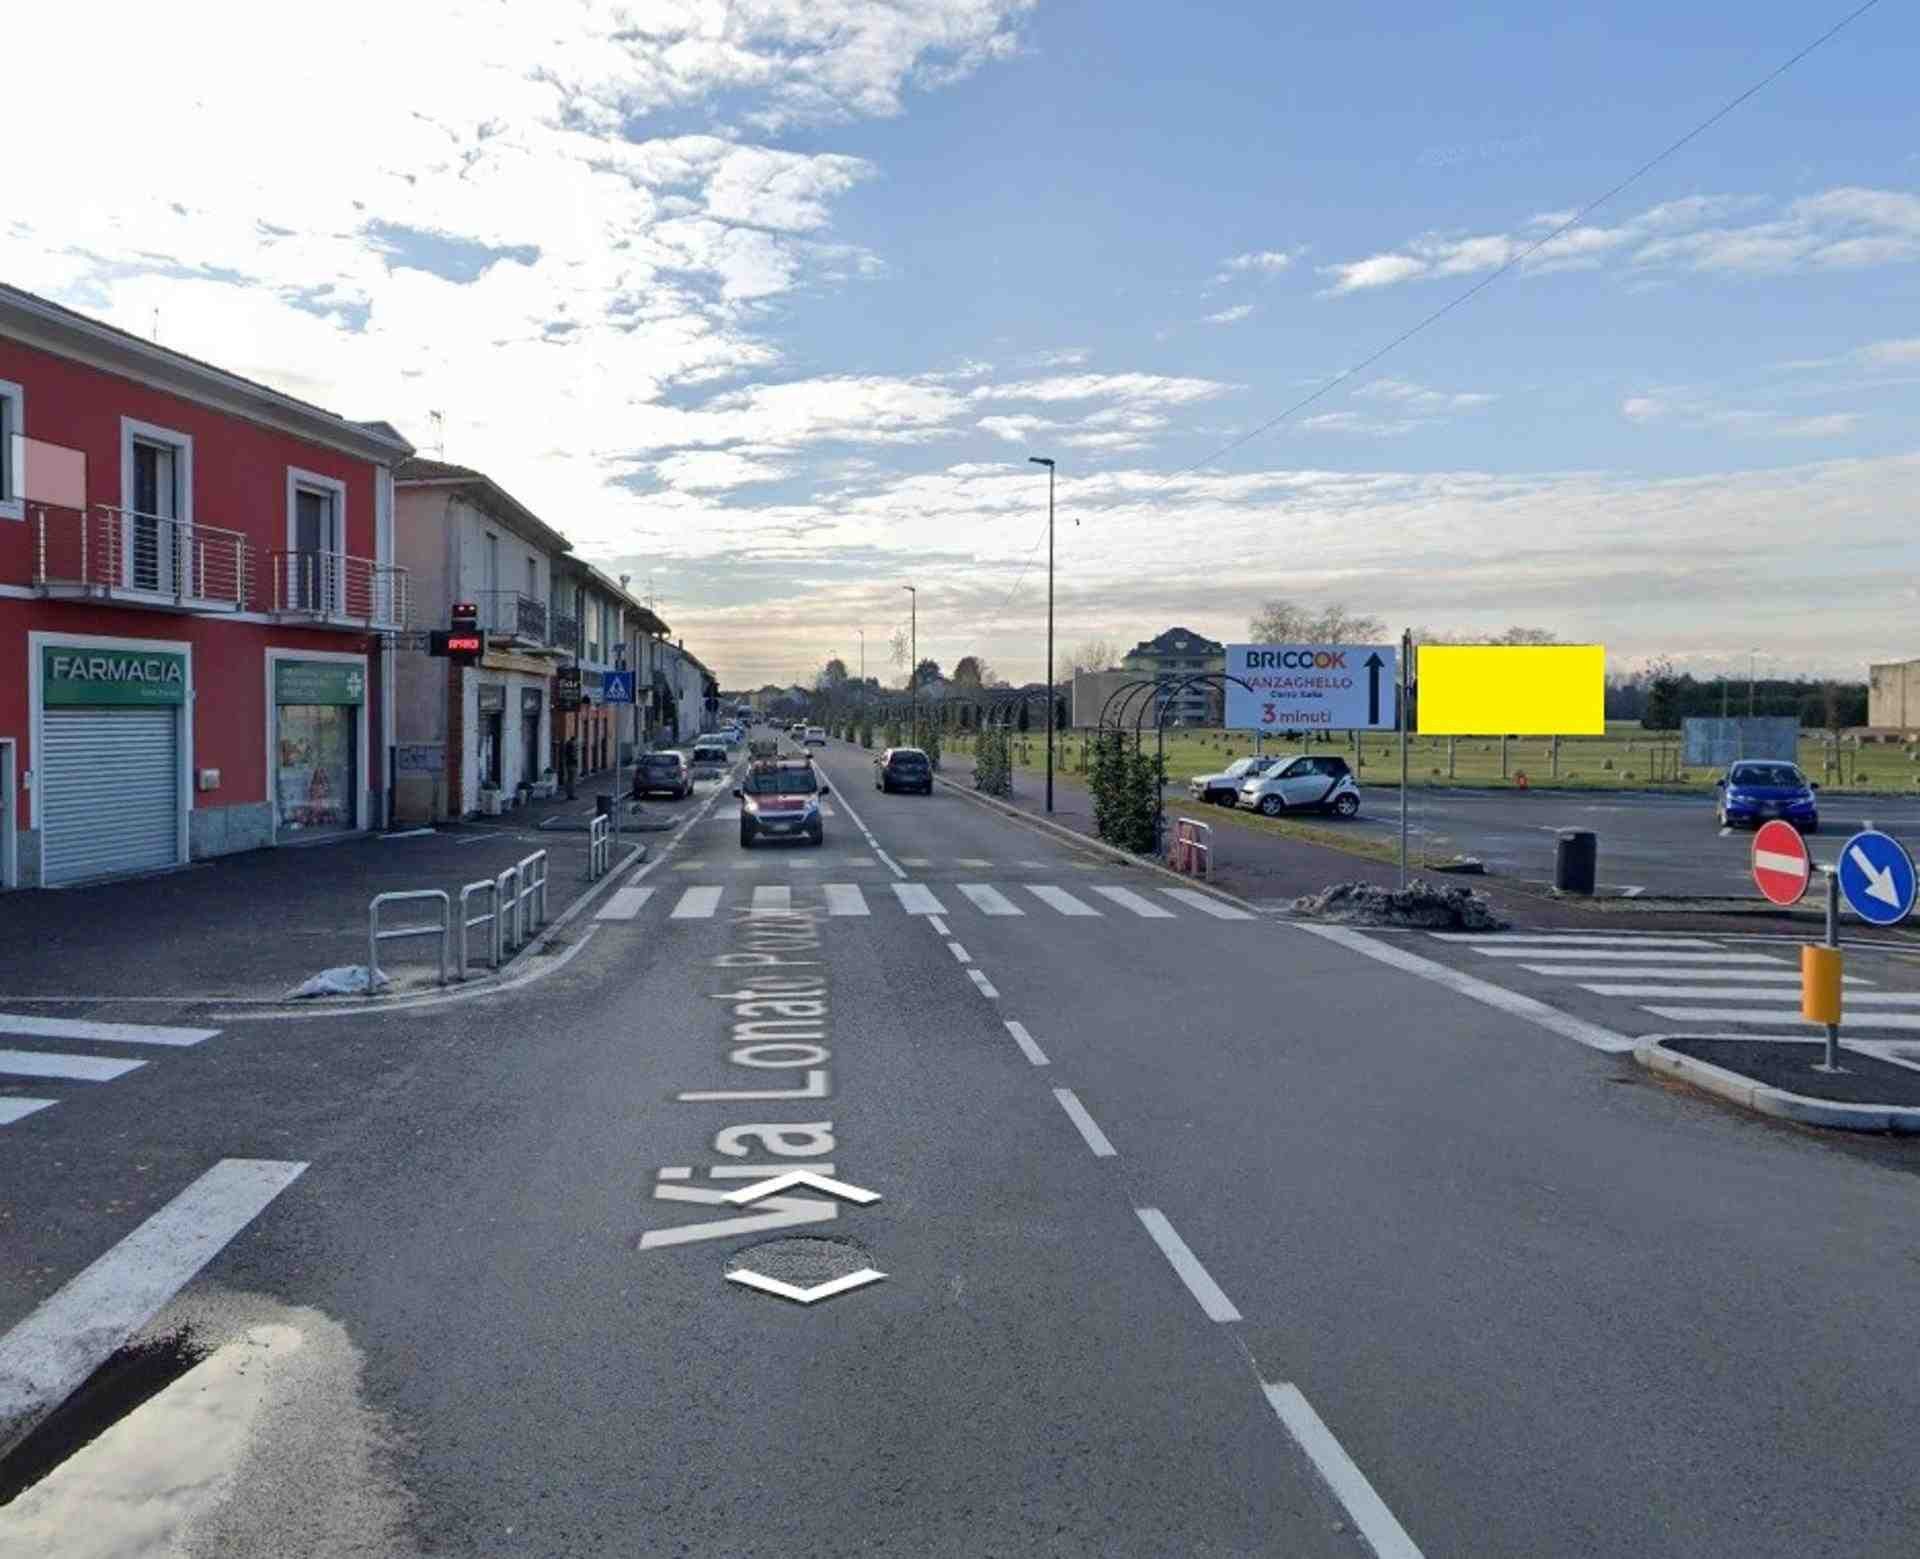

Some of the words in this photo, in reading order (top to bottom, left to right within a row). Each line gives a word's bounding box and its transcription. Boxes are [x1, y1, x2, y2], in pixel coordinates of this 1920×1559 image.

[52, 656, 183, 683] FARMACIA
[1262, 702, 1276, 724] 3
[1280, 709, 1332, 723] minuti
